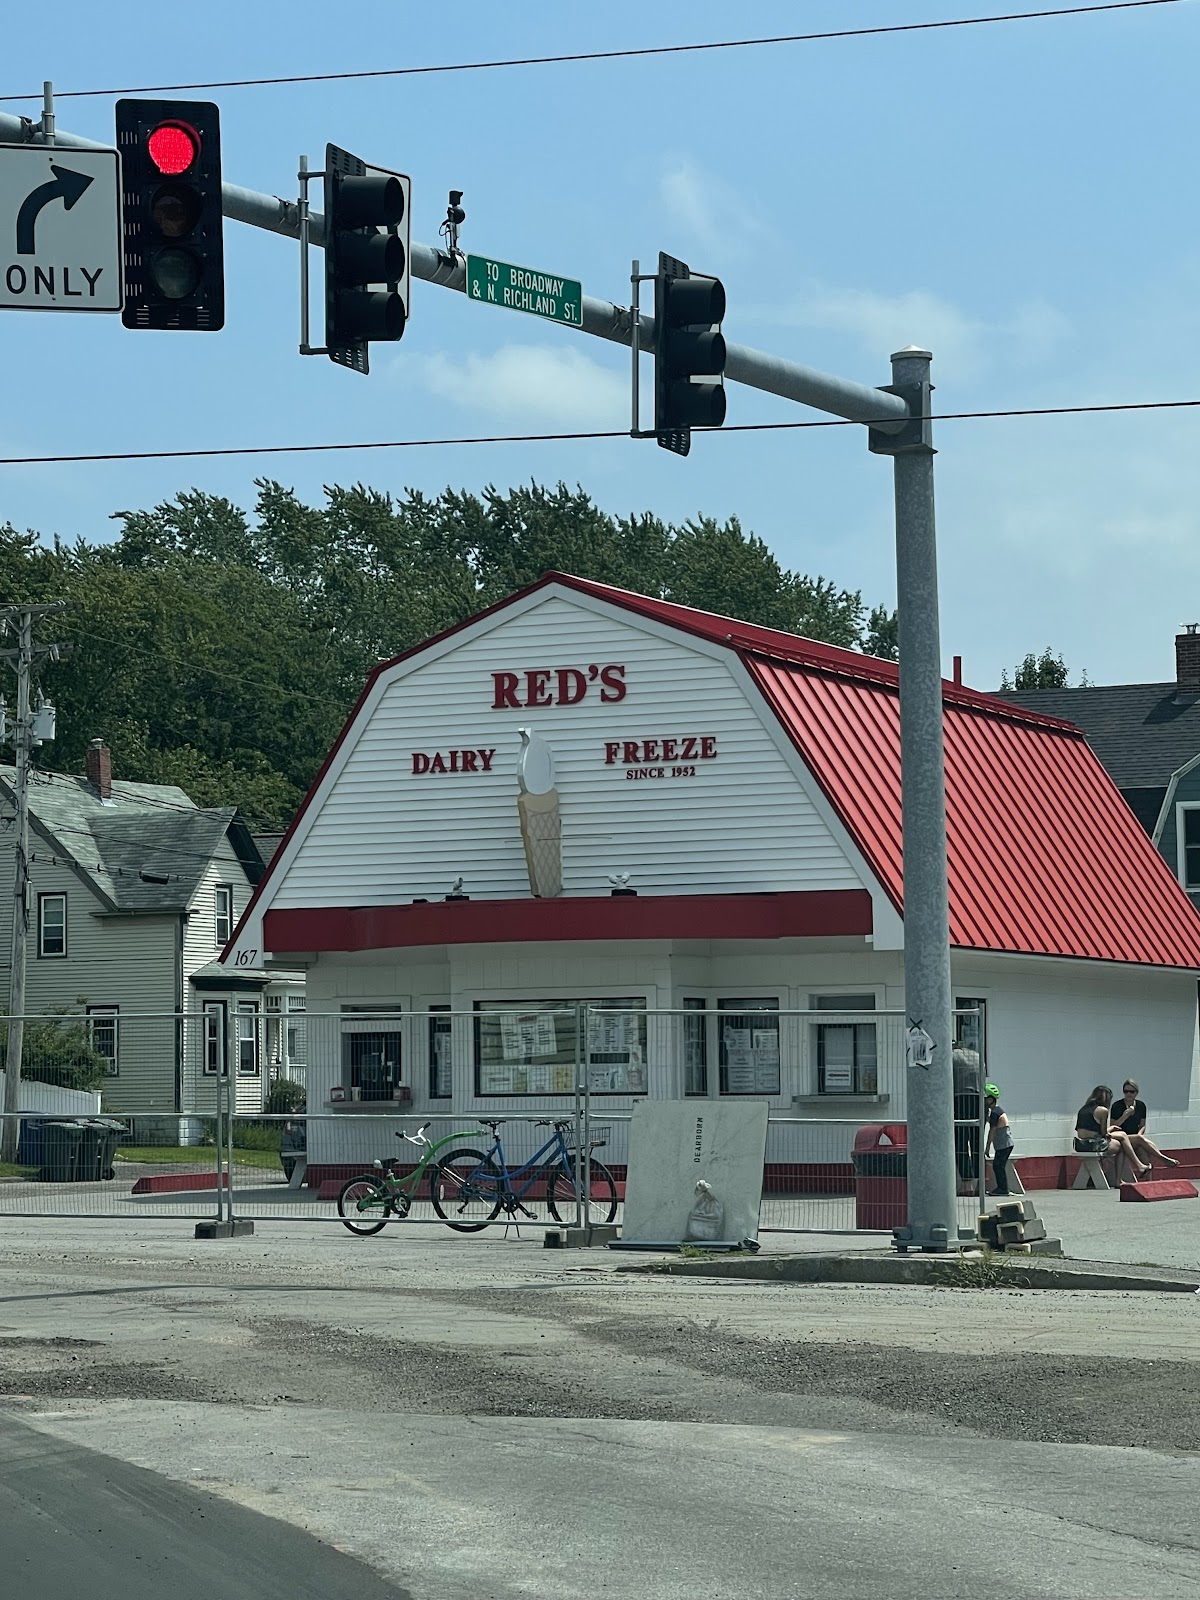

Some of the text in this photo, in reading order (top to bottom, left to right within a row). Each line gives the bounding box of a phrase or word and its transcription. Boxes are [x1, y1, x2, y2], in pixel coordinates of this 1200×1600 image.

[6, 264, 104, 296] ONLY
[486, 262, 564, 297] TO BROADWAY
[472, 279, 578, 321] & N. RICHLAND ST.
[490, 664, 627, 709] RED'S
[411, 736, 717, 774] DAIRY FREEZE
[626, 765, 696, 780] SINCE 1952
[234, 949, 258, 966] 167
[693, 1117, 704, 1163] DEARBORN
